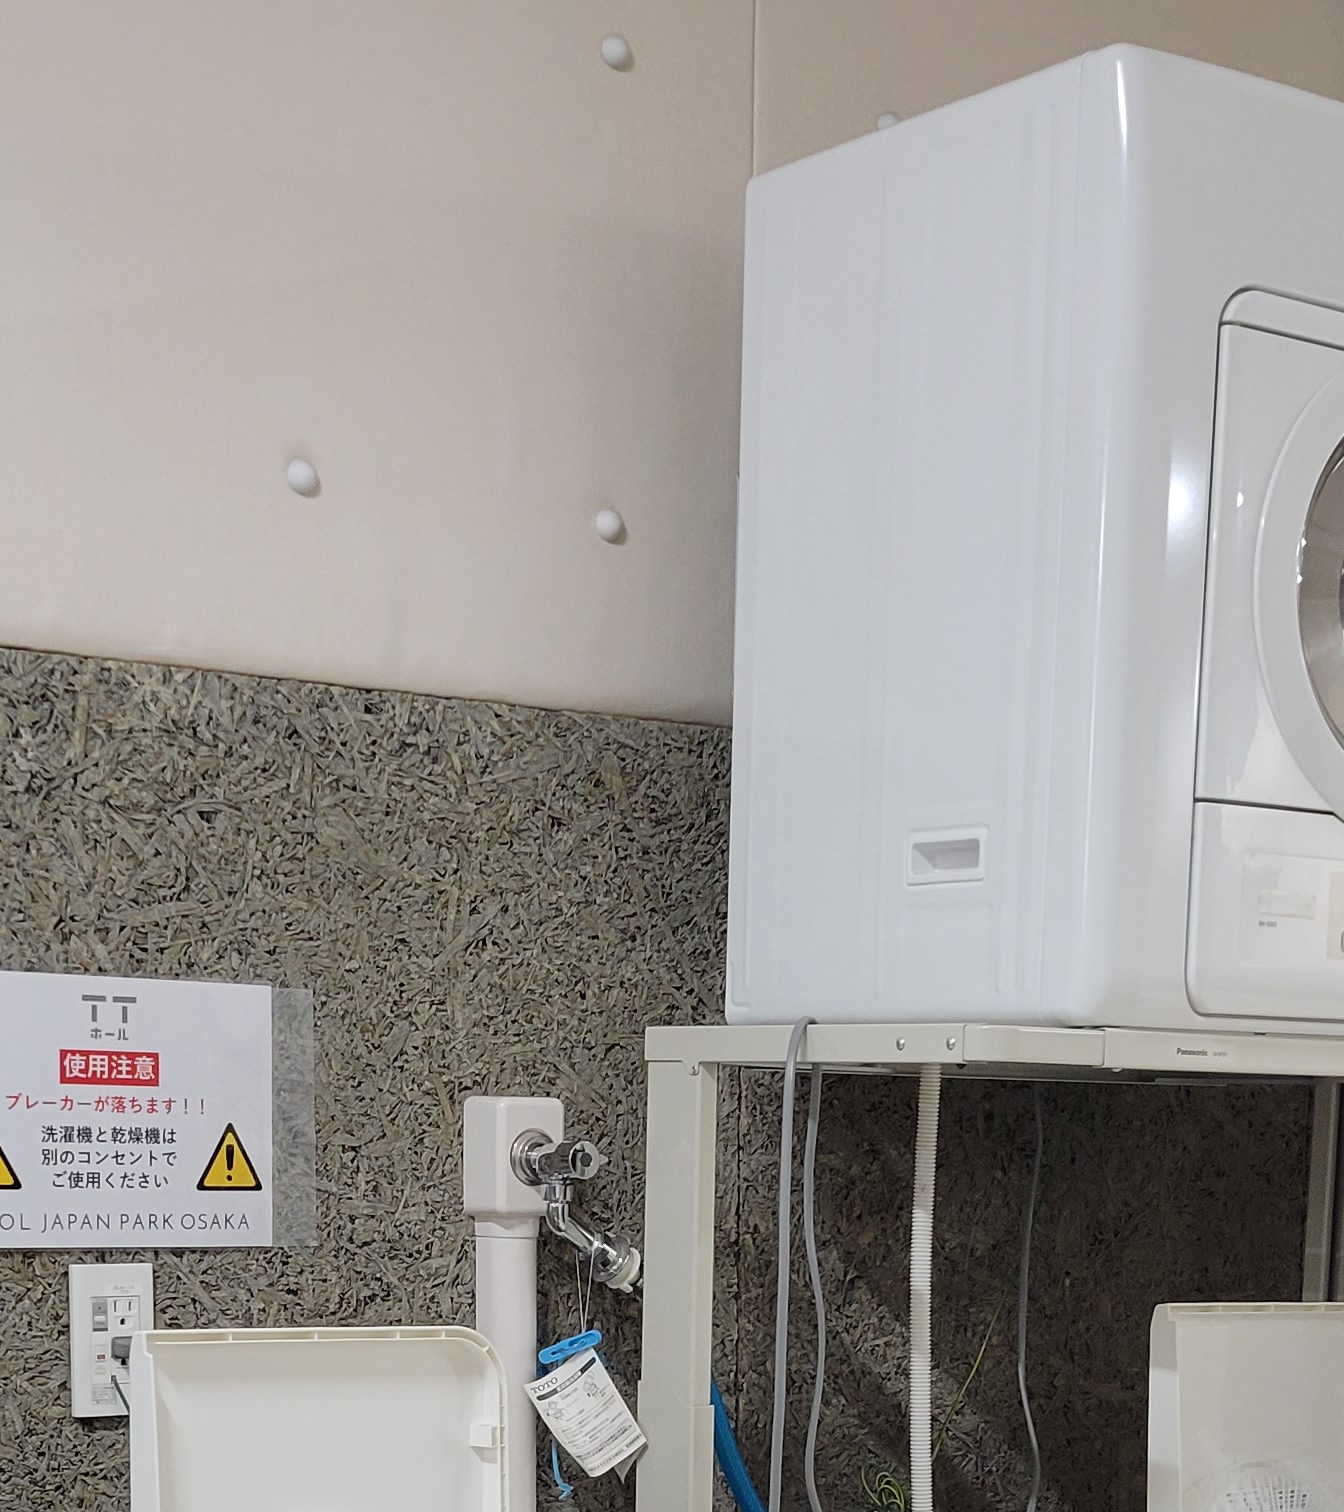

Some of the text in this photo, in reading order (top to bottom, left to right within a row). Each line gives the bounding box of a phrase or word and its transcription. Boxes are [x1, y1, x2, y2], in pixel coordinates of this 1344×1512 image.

[90, 1027, 129, 1041] ホール
[1176, 1047, 1208, 1057] Panasonic
[63, 1052, 156, 1081] 使用注意
[41, 1125, 177, 1145] 洗濯機と乾燥機は
[41, 1148, 178, 1167] 別のコンセントで
[52, 1170, 169, 1190] ご使用ください
[41, 1213, 111, 1233] JAPAN
[120, 1213, 174, 1231] PARK
[180, 1213, 250, 1231] OSAKA
[531, 1376, 559, 1395] TOTO
